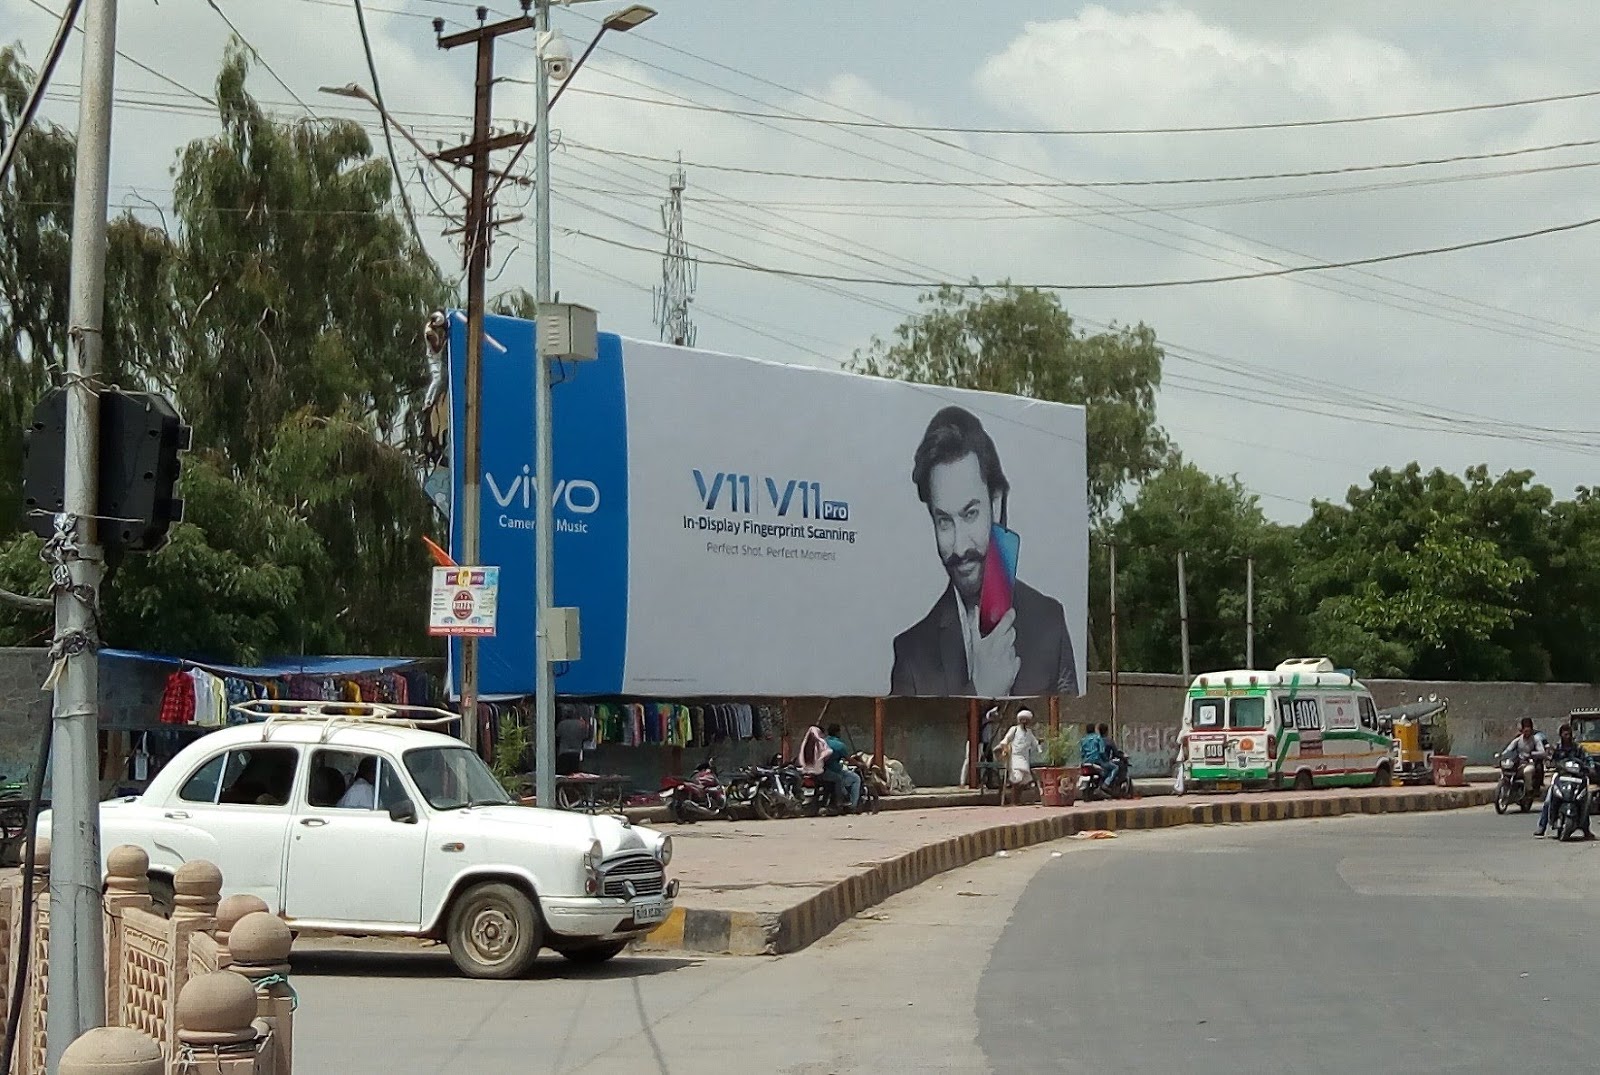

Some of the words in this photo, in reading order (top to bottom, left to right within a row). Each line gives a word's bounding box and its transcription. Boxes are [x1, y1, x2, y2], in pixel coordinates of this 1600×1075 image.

[485, 464, 600, 514] vivo
[693, 469, 750, 513] V11
[765, 477, 820, 519] V11
[824, 503, 847, 519] Pro
[499, 515, 536, 529] Camer
[556, 519, 588, 533] Music
[683, 515, 740, 535] In-Display
[743, 520, 805, 539] Fingerprint
[807, 525, 856, 544] Scanning
[706, 541, 739, 556] Perfect
[766, 546, 799, 560] Perfect
[800, 549, 836, 562] Moment
